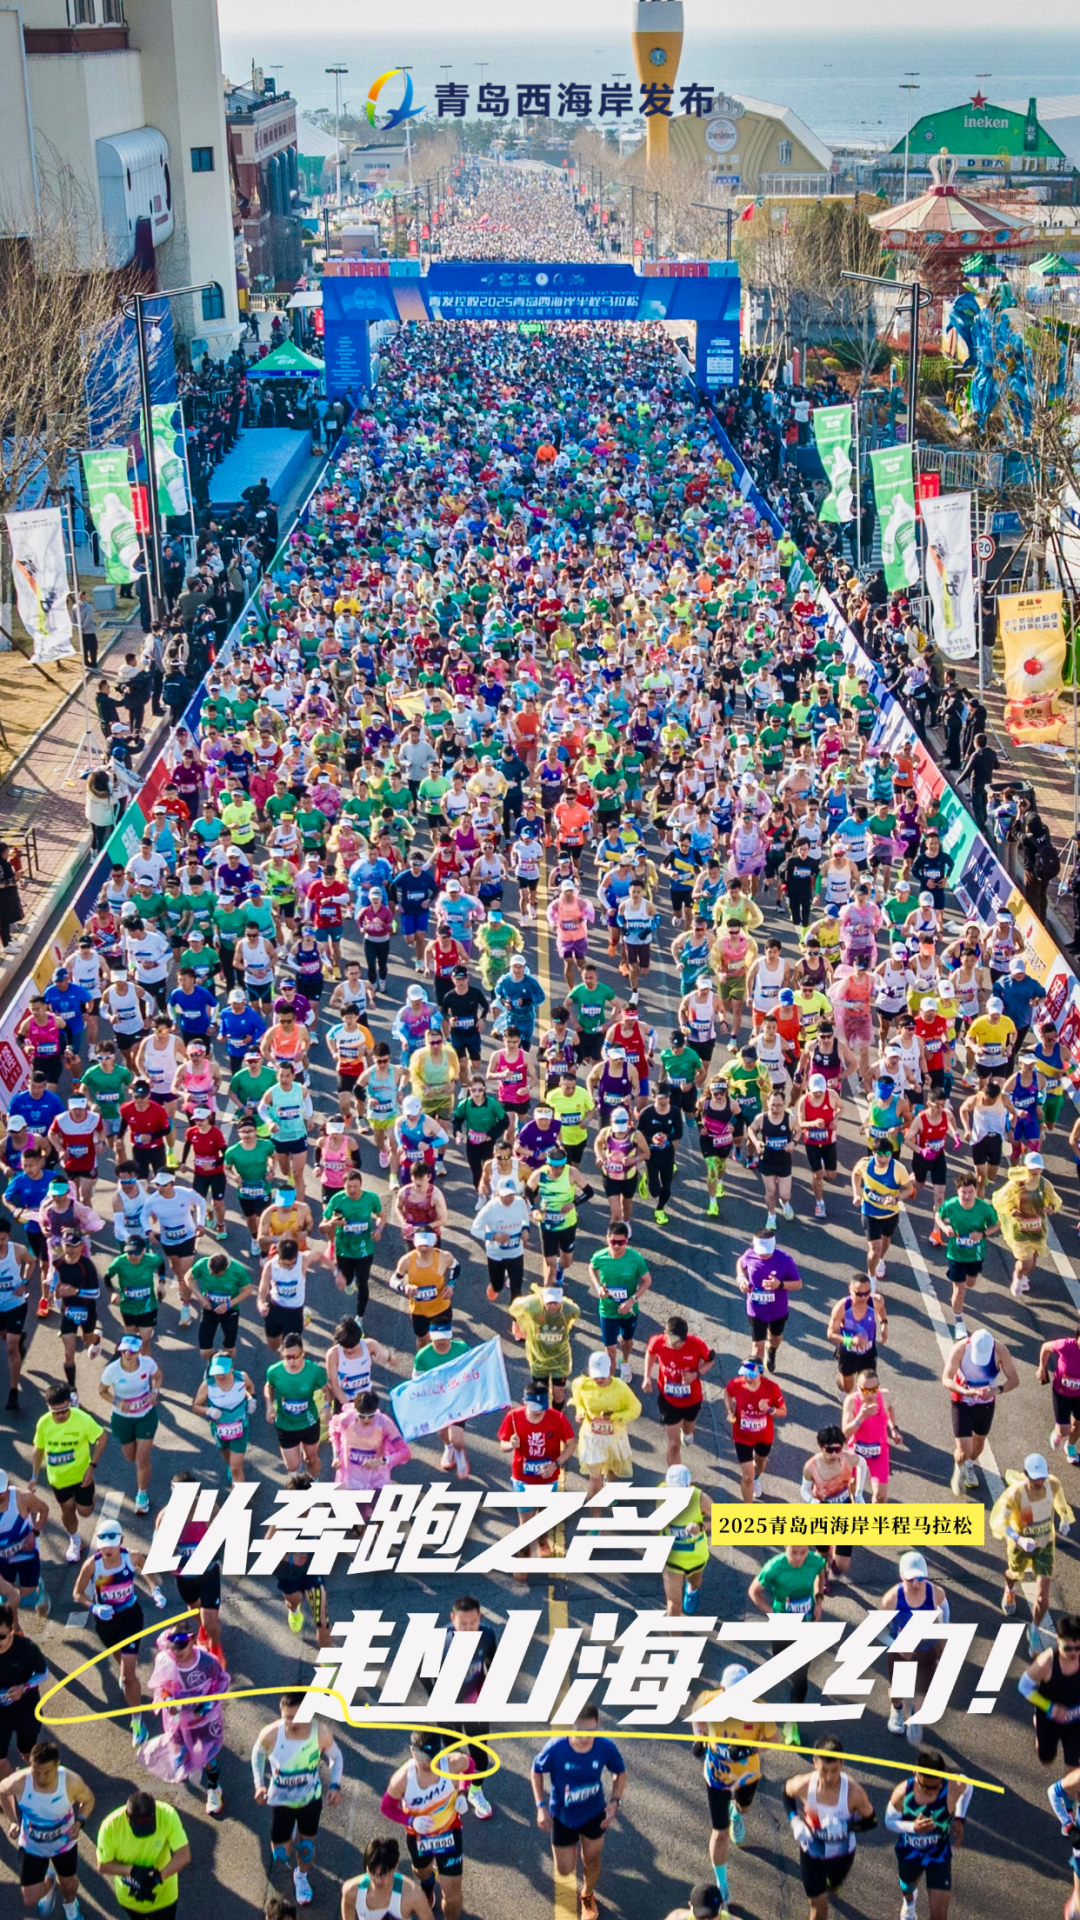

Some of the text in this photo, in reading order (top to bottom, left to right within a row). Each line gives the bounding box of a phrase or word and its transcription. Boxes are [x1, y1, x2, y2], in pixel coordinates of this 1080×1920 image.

[964, 115, 1009, 128] ineken
[978, 543, 991, 553] 20
[225, 1424, 243, 1436] 2293
[112, 1588, 132, 1599] 1564
[430, 1837, 453, 1849] 1890
